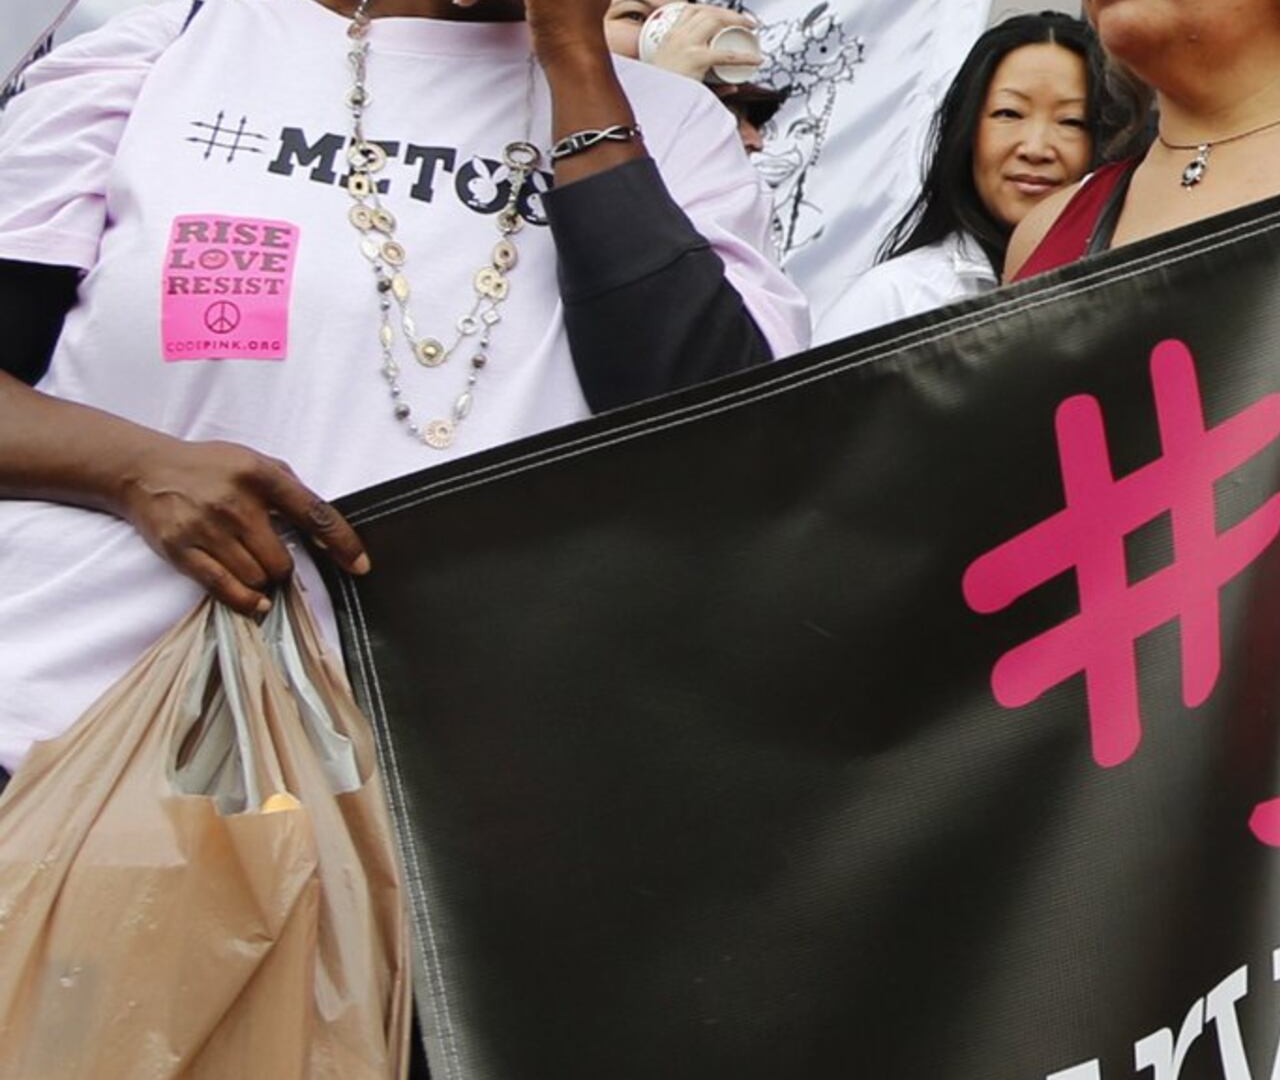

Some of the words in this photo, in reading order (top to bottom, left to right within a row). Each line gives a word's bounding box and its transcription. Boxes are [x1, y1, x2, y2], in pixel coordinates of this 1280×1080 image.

[173, 220, 292, 249] RISE
[168, 248, 288, 273] LOVE
[166, 276, 285, 295] RESIST
